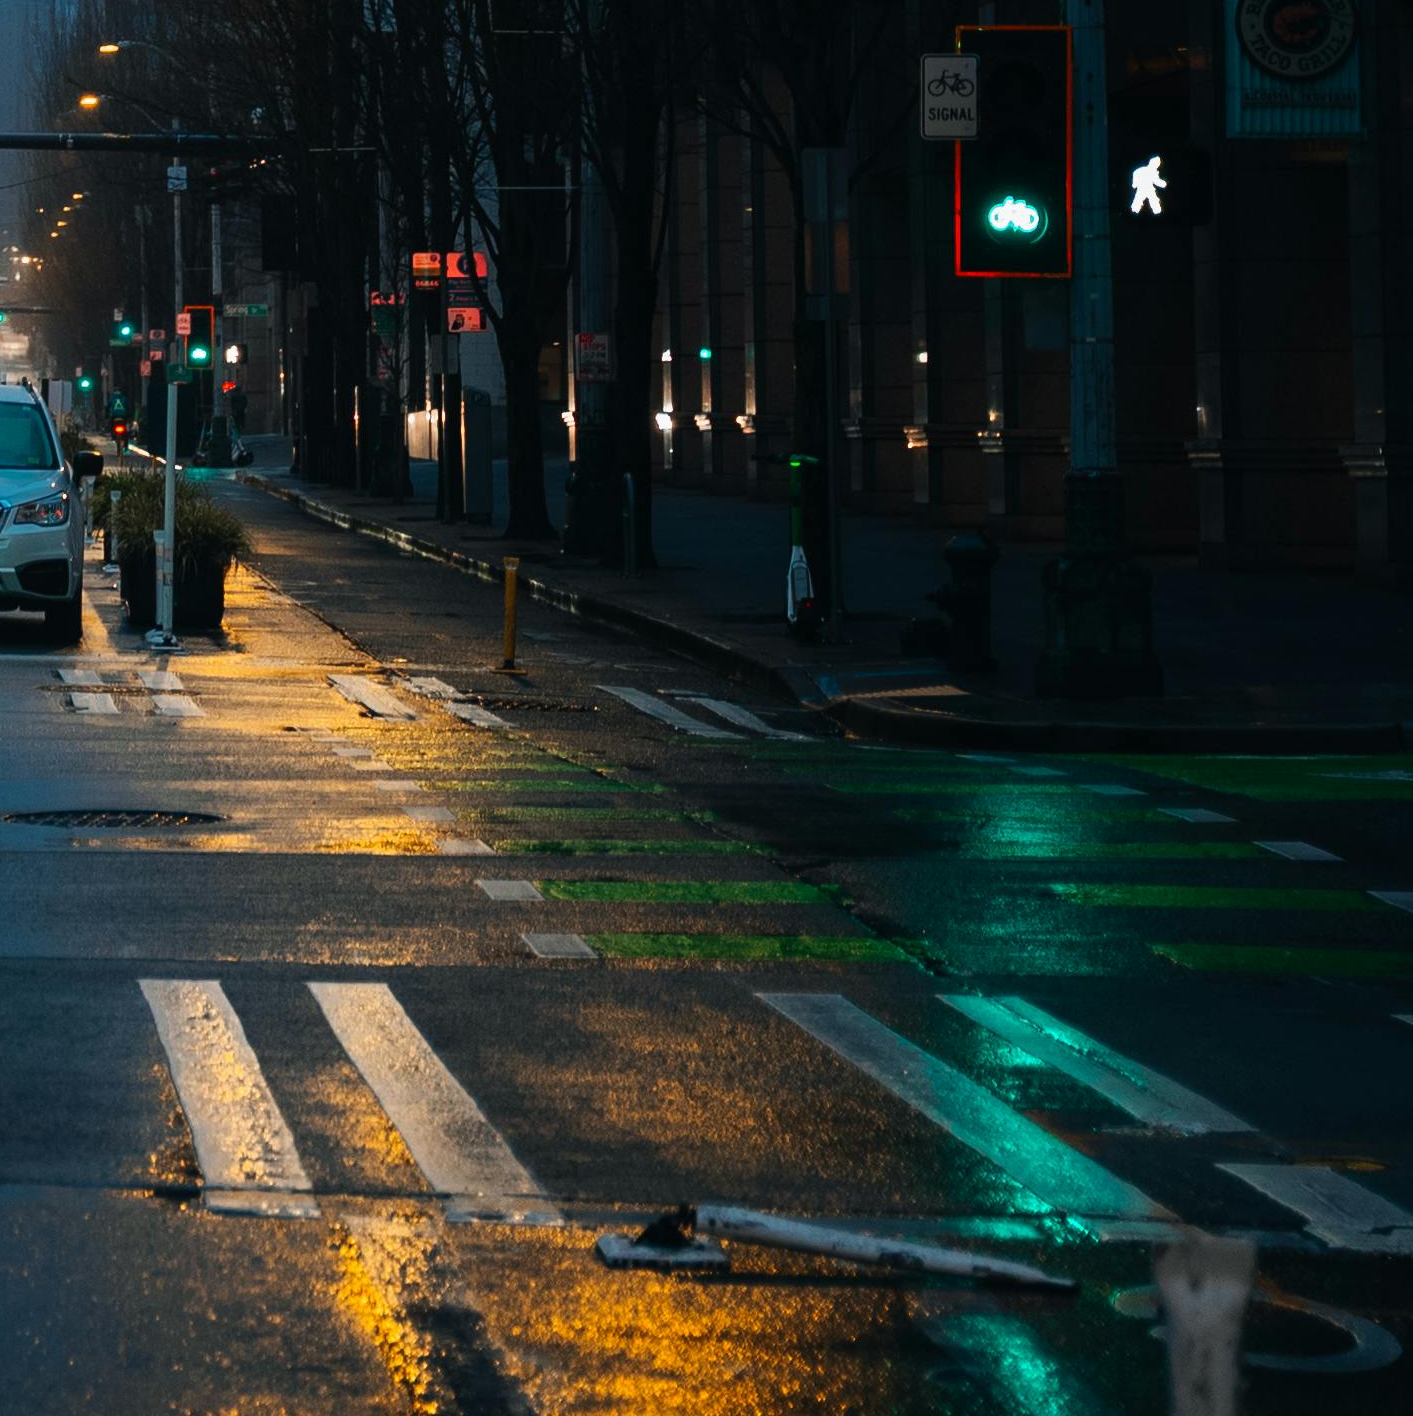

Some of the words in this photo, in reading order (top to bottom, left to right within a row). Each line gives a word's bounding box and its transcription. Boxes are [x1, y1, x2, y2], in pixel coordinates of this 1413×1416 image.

[1251, 33, 1292, 71] TACO
[1298, 33, 1346, 72] GRILL
[928, 107, 975, 121] SIGNAL
